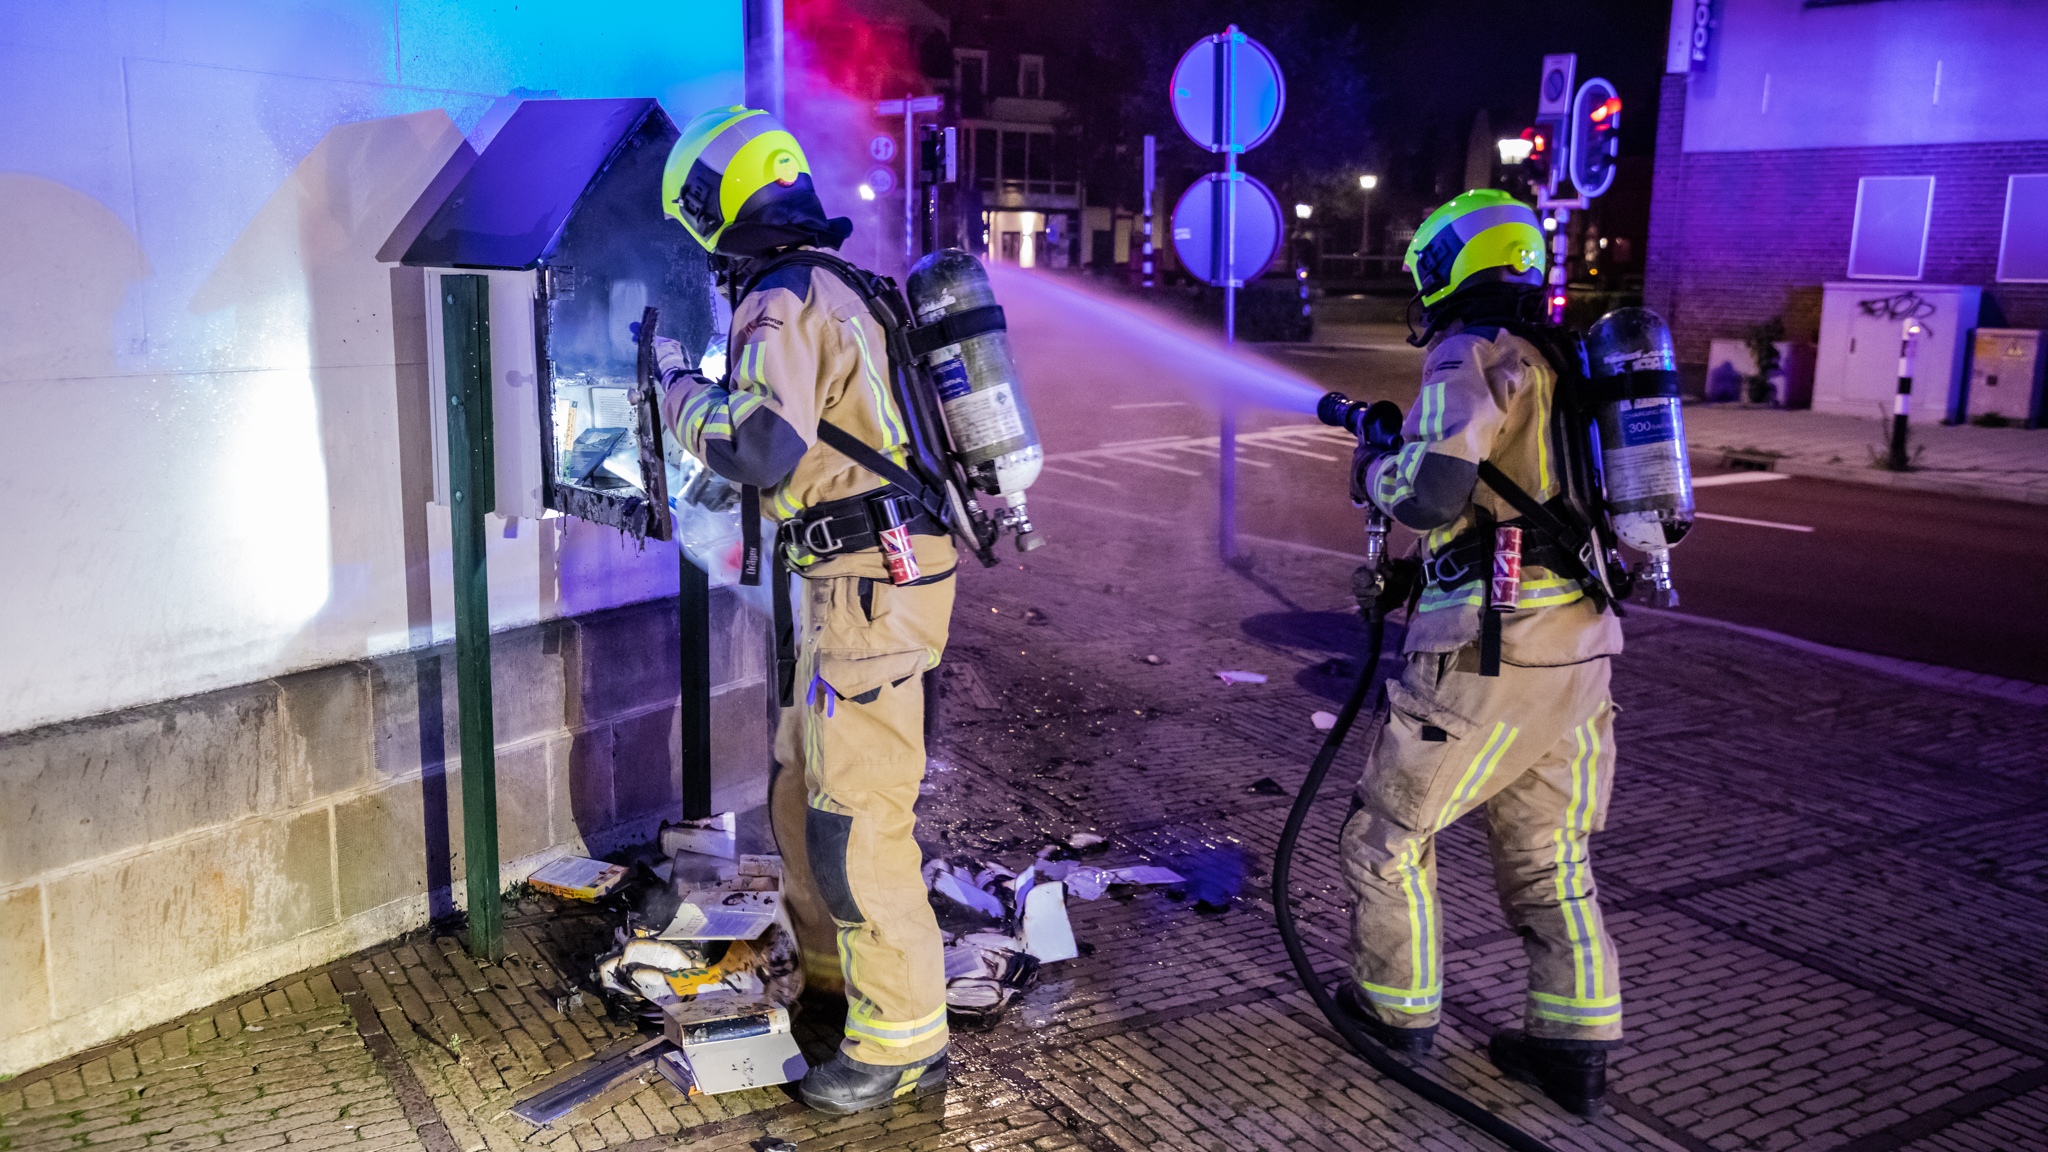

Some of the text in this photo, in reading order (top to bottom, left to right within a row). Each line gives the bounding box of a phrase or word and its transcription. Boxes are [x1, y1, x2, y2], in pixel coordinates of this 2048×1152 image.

[1692, 0, 1710, 61] FOO
[1628, 421, 1651, 434] 300
[746, 547, 758, 575] Dräger
